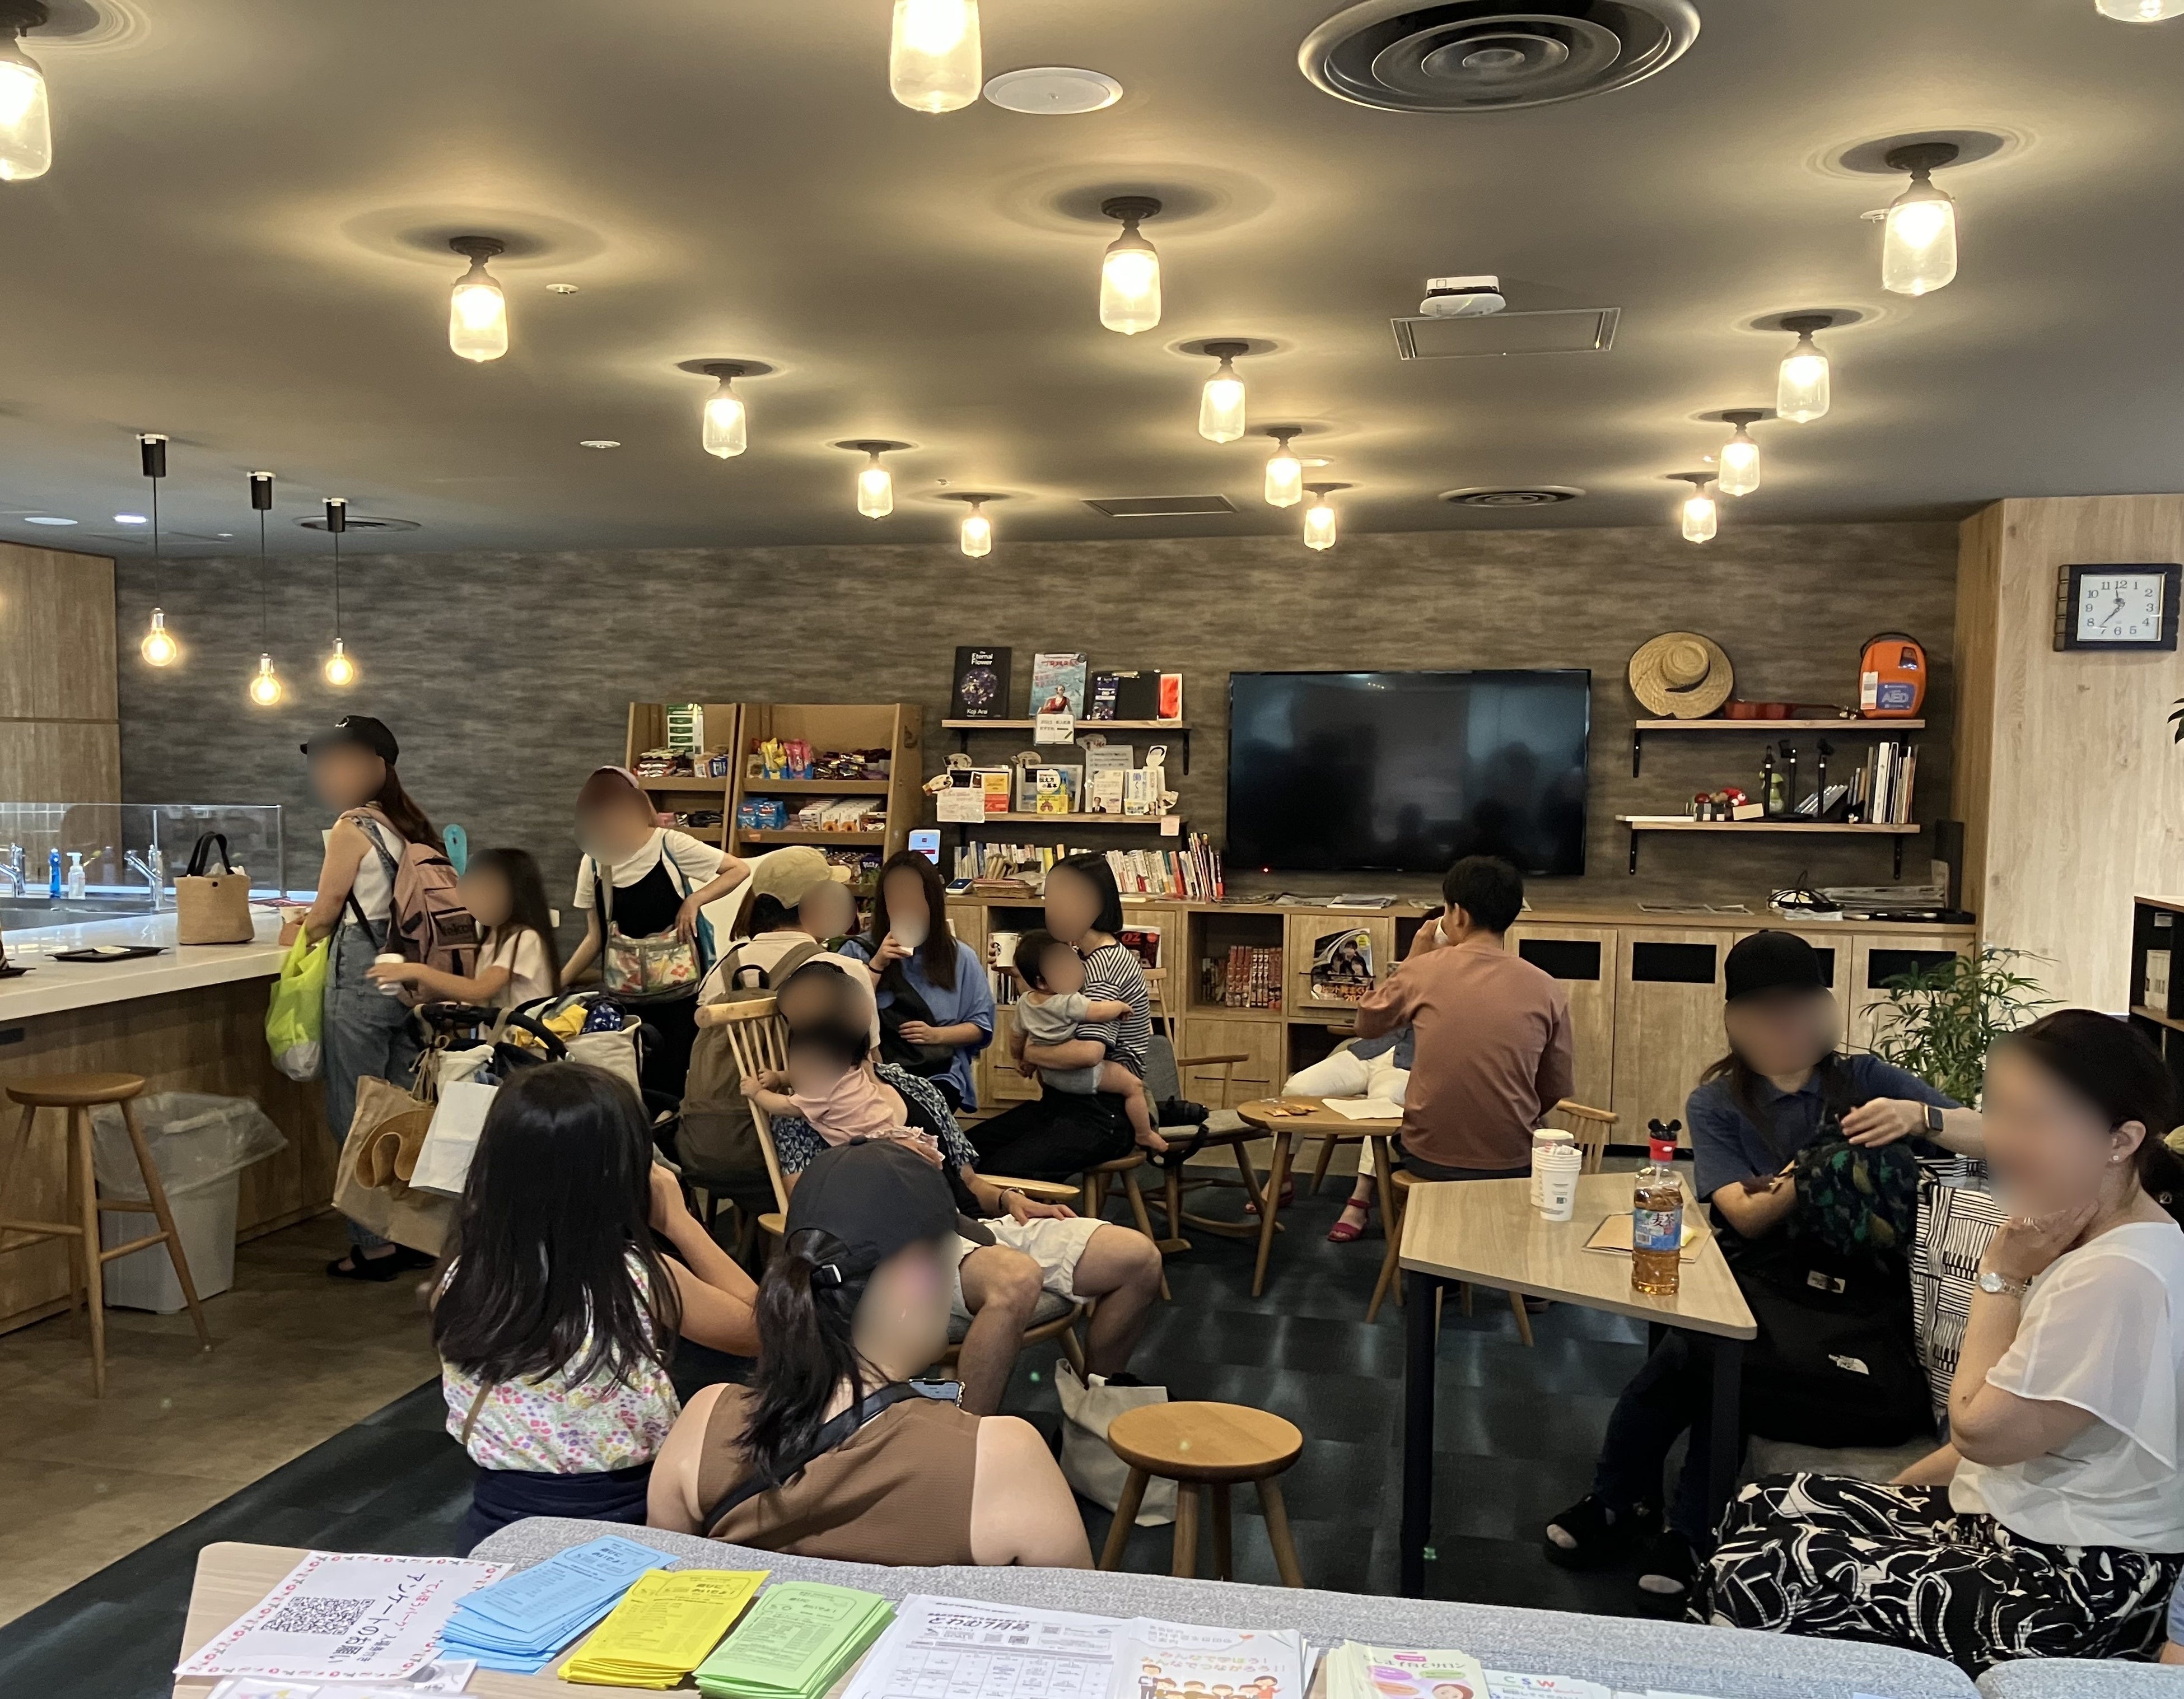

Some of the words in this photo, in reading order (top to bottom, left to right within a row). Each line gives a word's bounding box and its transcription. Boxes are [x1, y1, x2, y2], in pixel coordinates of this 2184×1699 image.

[2101, 582, 2111, 590] 11
[2115, 581, 2127, 589] 12
[2088, 590, 2099, 599] 10
[2146, 604, 2154, 612] 3
[2087, 618, 2094, 627] 8
[2100, 627, 2107, 635] 7
[2114, 627, 2121, 635] 6
[2129, 626, 2136, 634] 5
[1882, 692, 1909, 703] AED
[1652, 1213, 1675, 1226] 麦茶
[328, 1573, 427, 1664] アンケートのお願い
